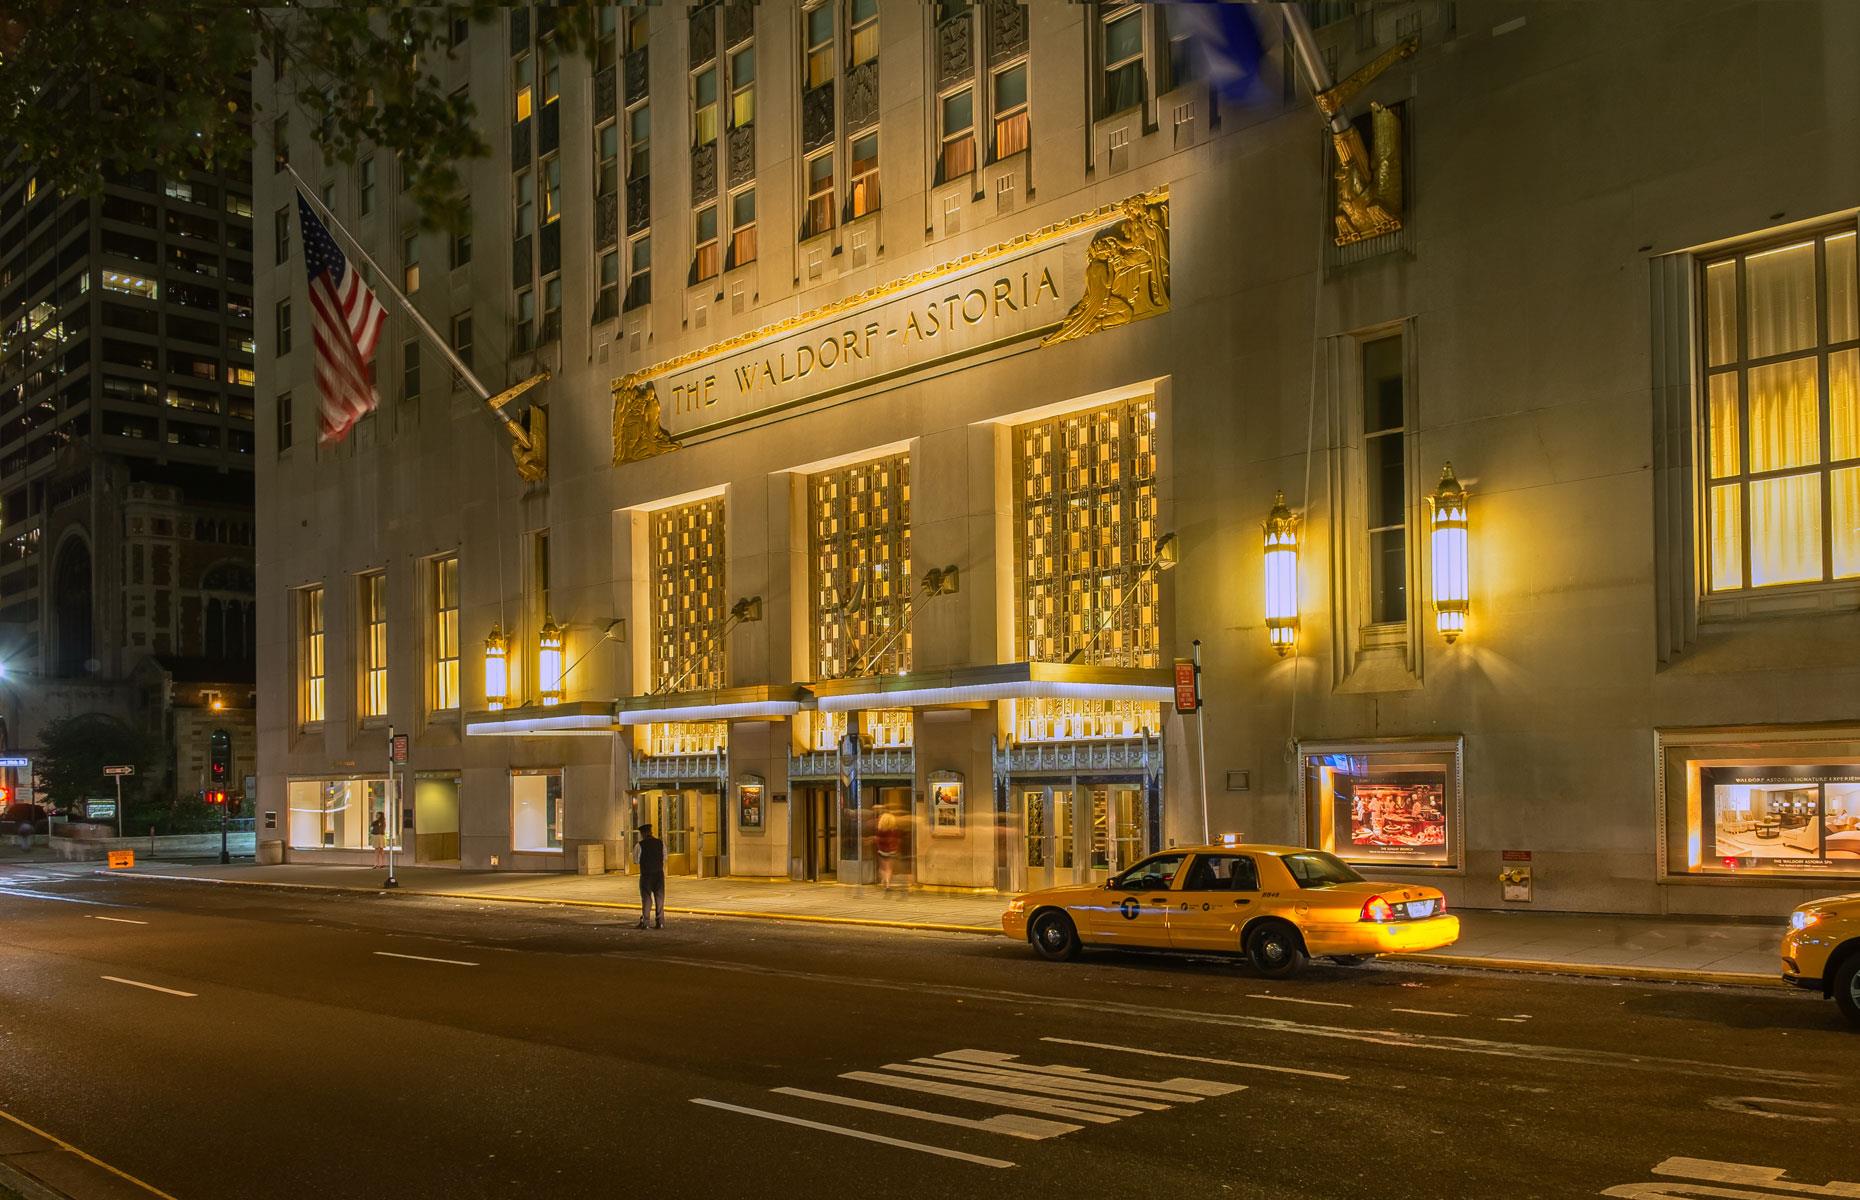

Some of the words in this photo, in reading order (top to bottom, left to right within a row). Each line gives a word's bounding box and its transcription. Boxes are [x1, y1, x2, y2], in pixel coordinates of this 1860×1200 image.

[672, 375, 718, 415] THE
[734, 266, 1060, 394] WALDORF-ASTORIA
[1125, 901, 1137, 917] T
[770, 1048, 1249, 1140] LANE
